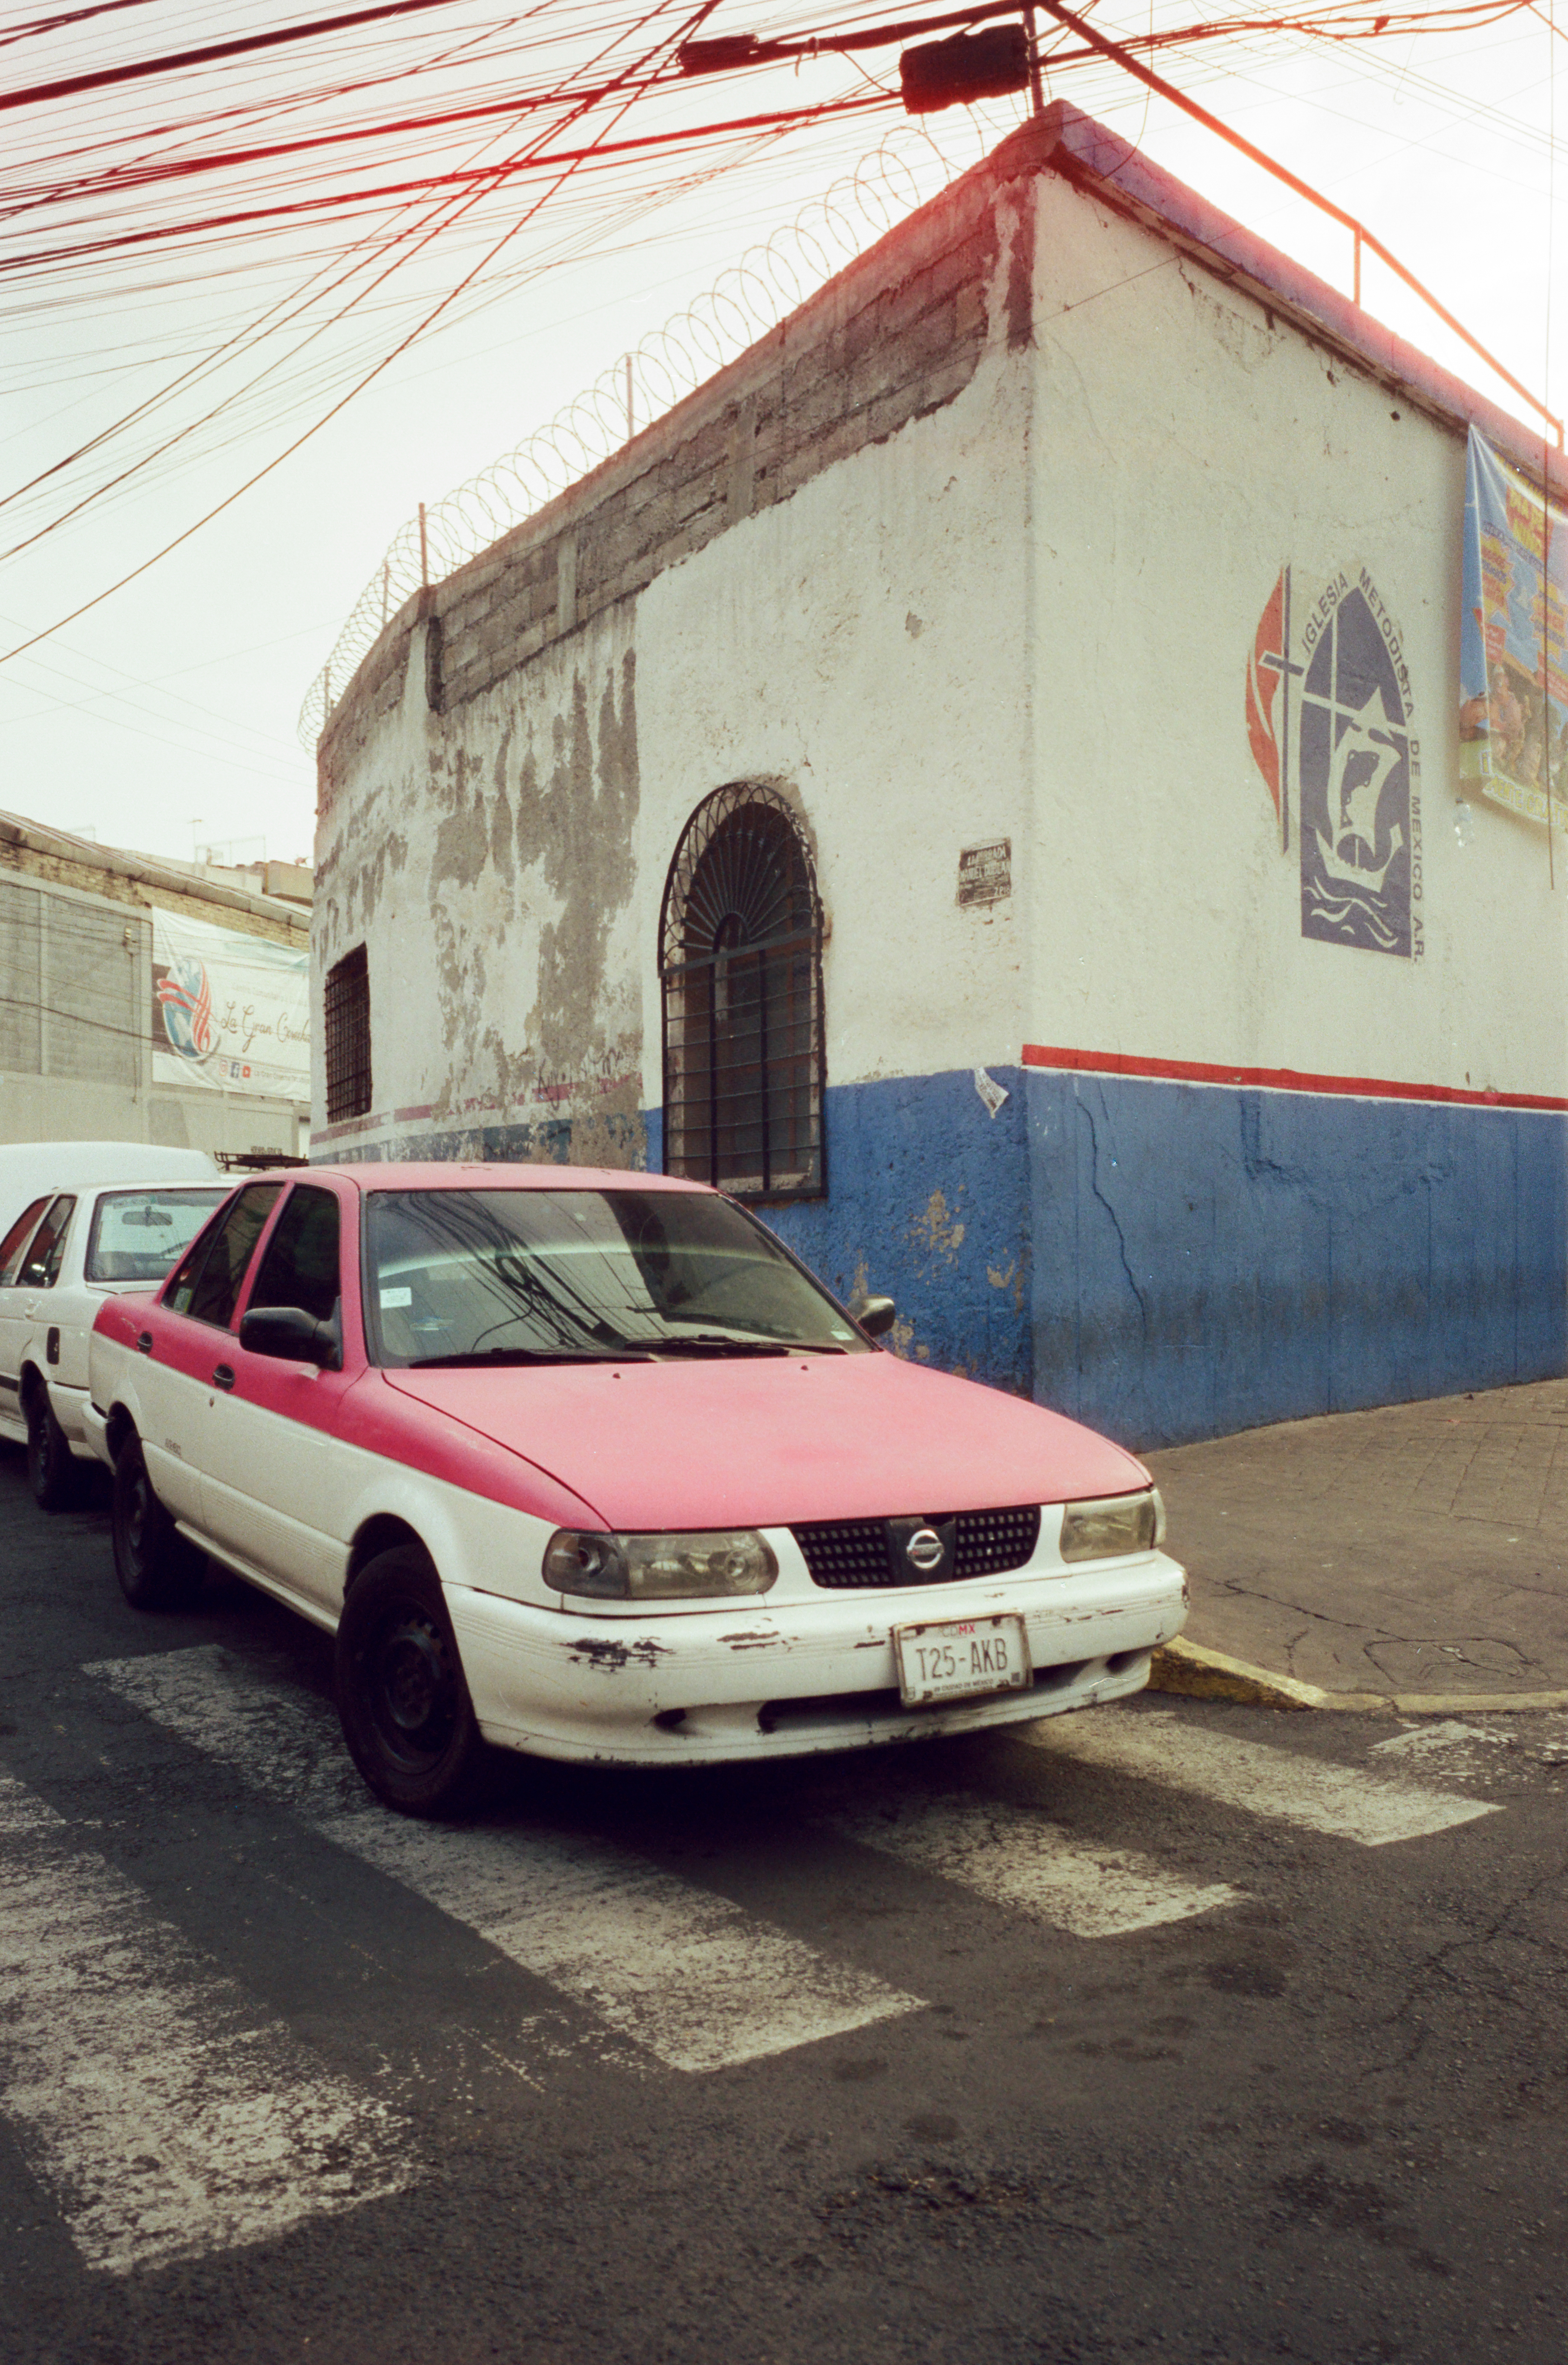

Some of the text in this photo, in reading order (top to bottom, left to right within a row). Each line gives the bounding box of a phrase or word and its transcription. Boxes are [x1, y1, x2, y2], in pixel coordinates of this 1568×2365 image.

[1301, 567, 1425, 963] IGLESIA METODISTA DE MEXICO A.R.
[221, 1001, 238, 1034] La
[242, 1005, 272, 1053] Gran
[941, 1624, 976, 1637] CDMX
[916, 1638, 1008, 1681] T25-AKB
